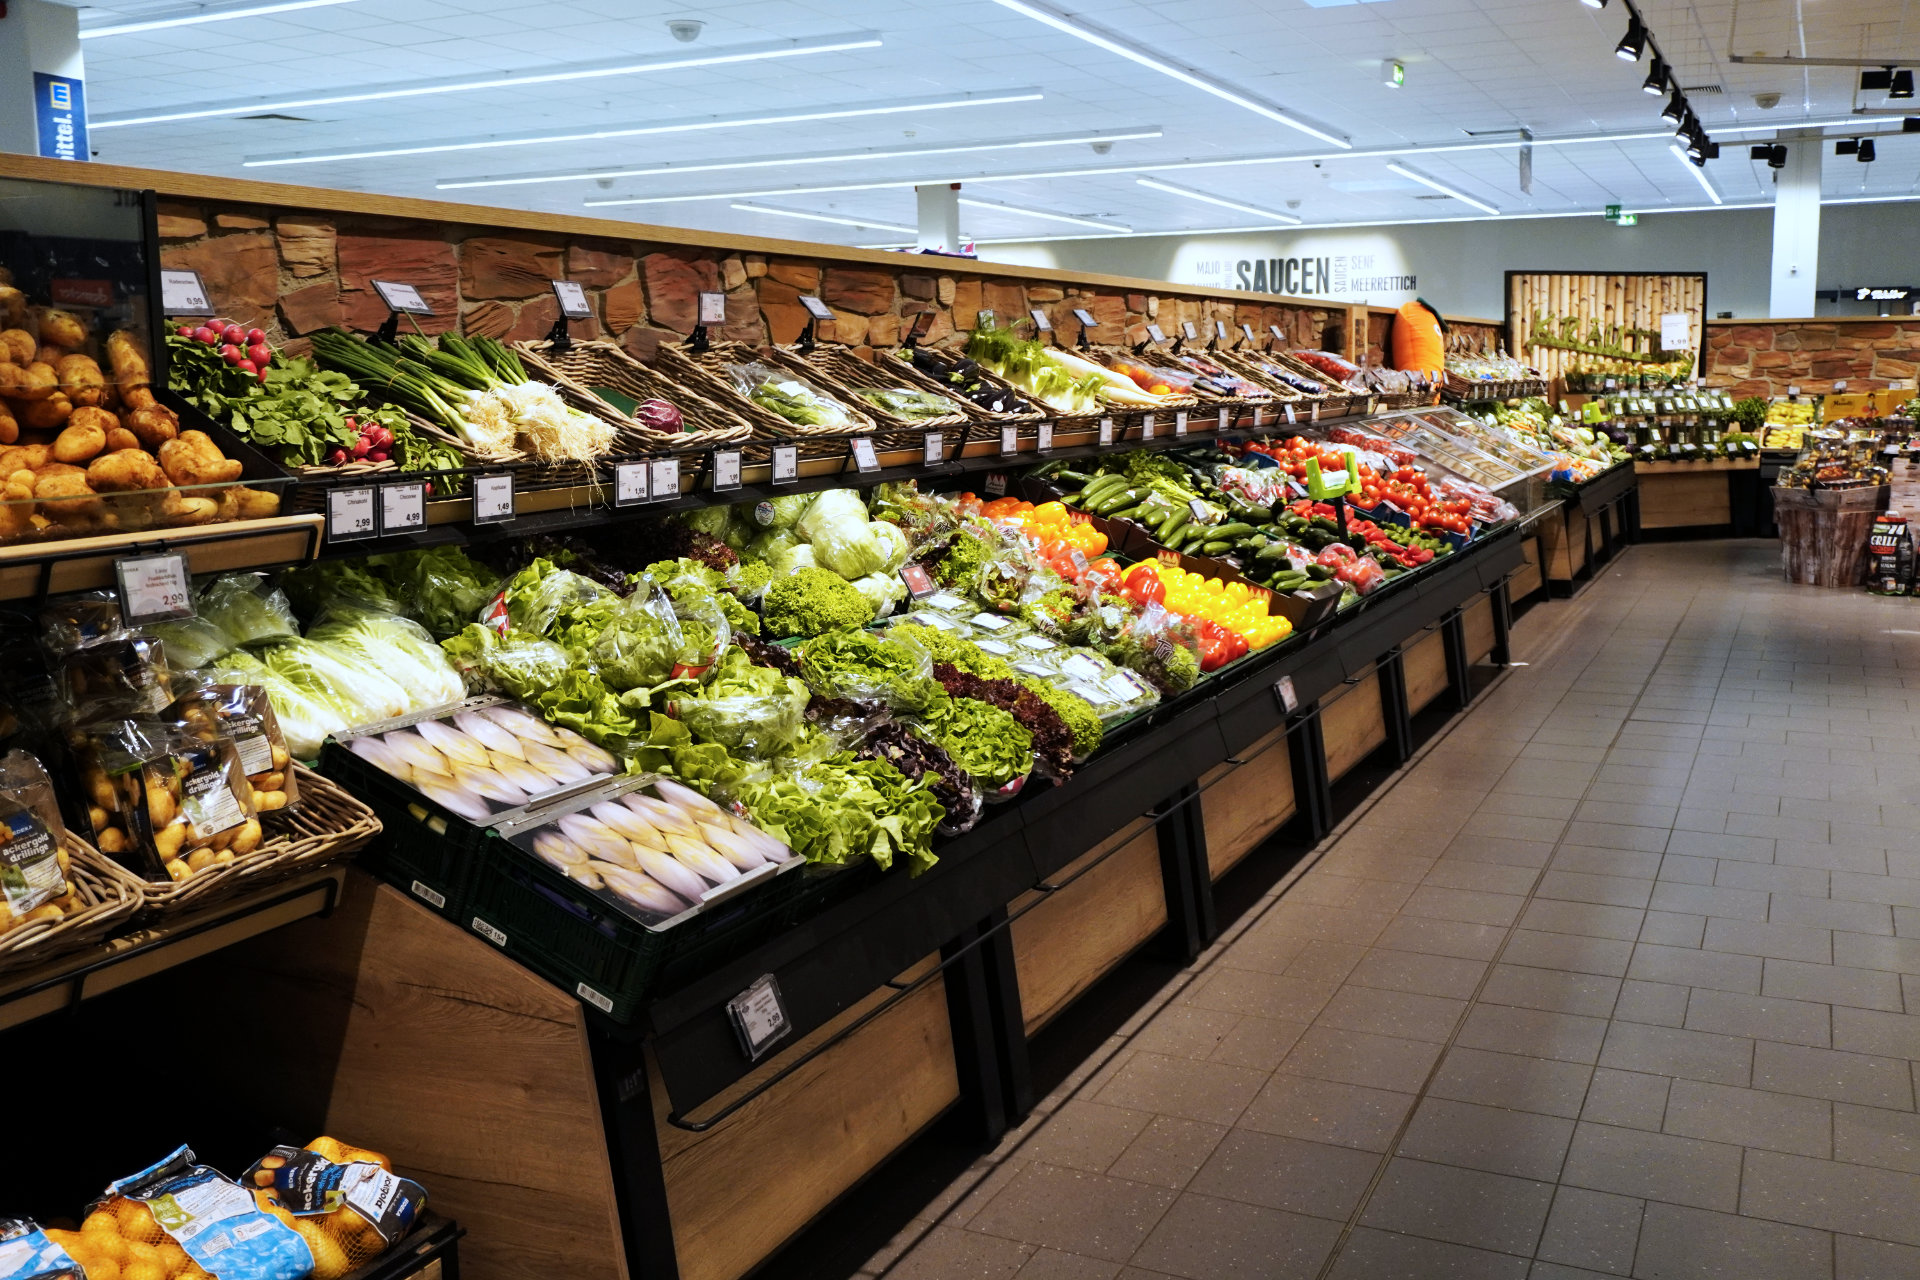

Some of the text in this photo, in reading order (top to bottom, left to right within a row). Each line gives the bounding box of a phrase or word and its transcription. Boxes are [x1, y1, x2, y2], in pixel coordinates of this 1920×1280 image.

[53, 113, 75, 160] ittel.
[1351, 255, 1376, 270] SENF
[1236, 257, 1330, 294] SAUCEN
[1334, 256, 1347, 293] SAUCEN
[1351, 275, 1417, 292] MEERRETTICH
[497, 502, 510, 511] 1,49
[355, 518, 371, 528] 2,99
[406, 512, 420, 522] 4,99
[162, 593, 184, 606] 2,99
[185, 770, 220, 788] ackergold
[2, 832, 49, 856] ackergold
[9, 843, 49, 863] drillinge
